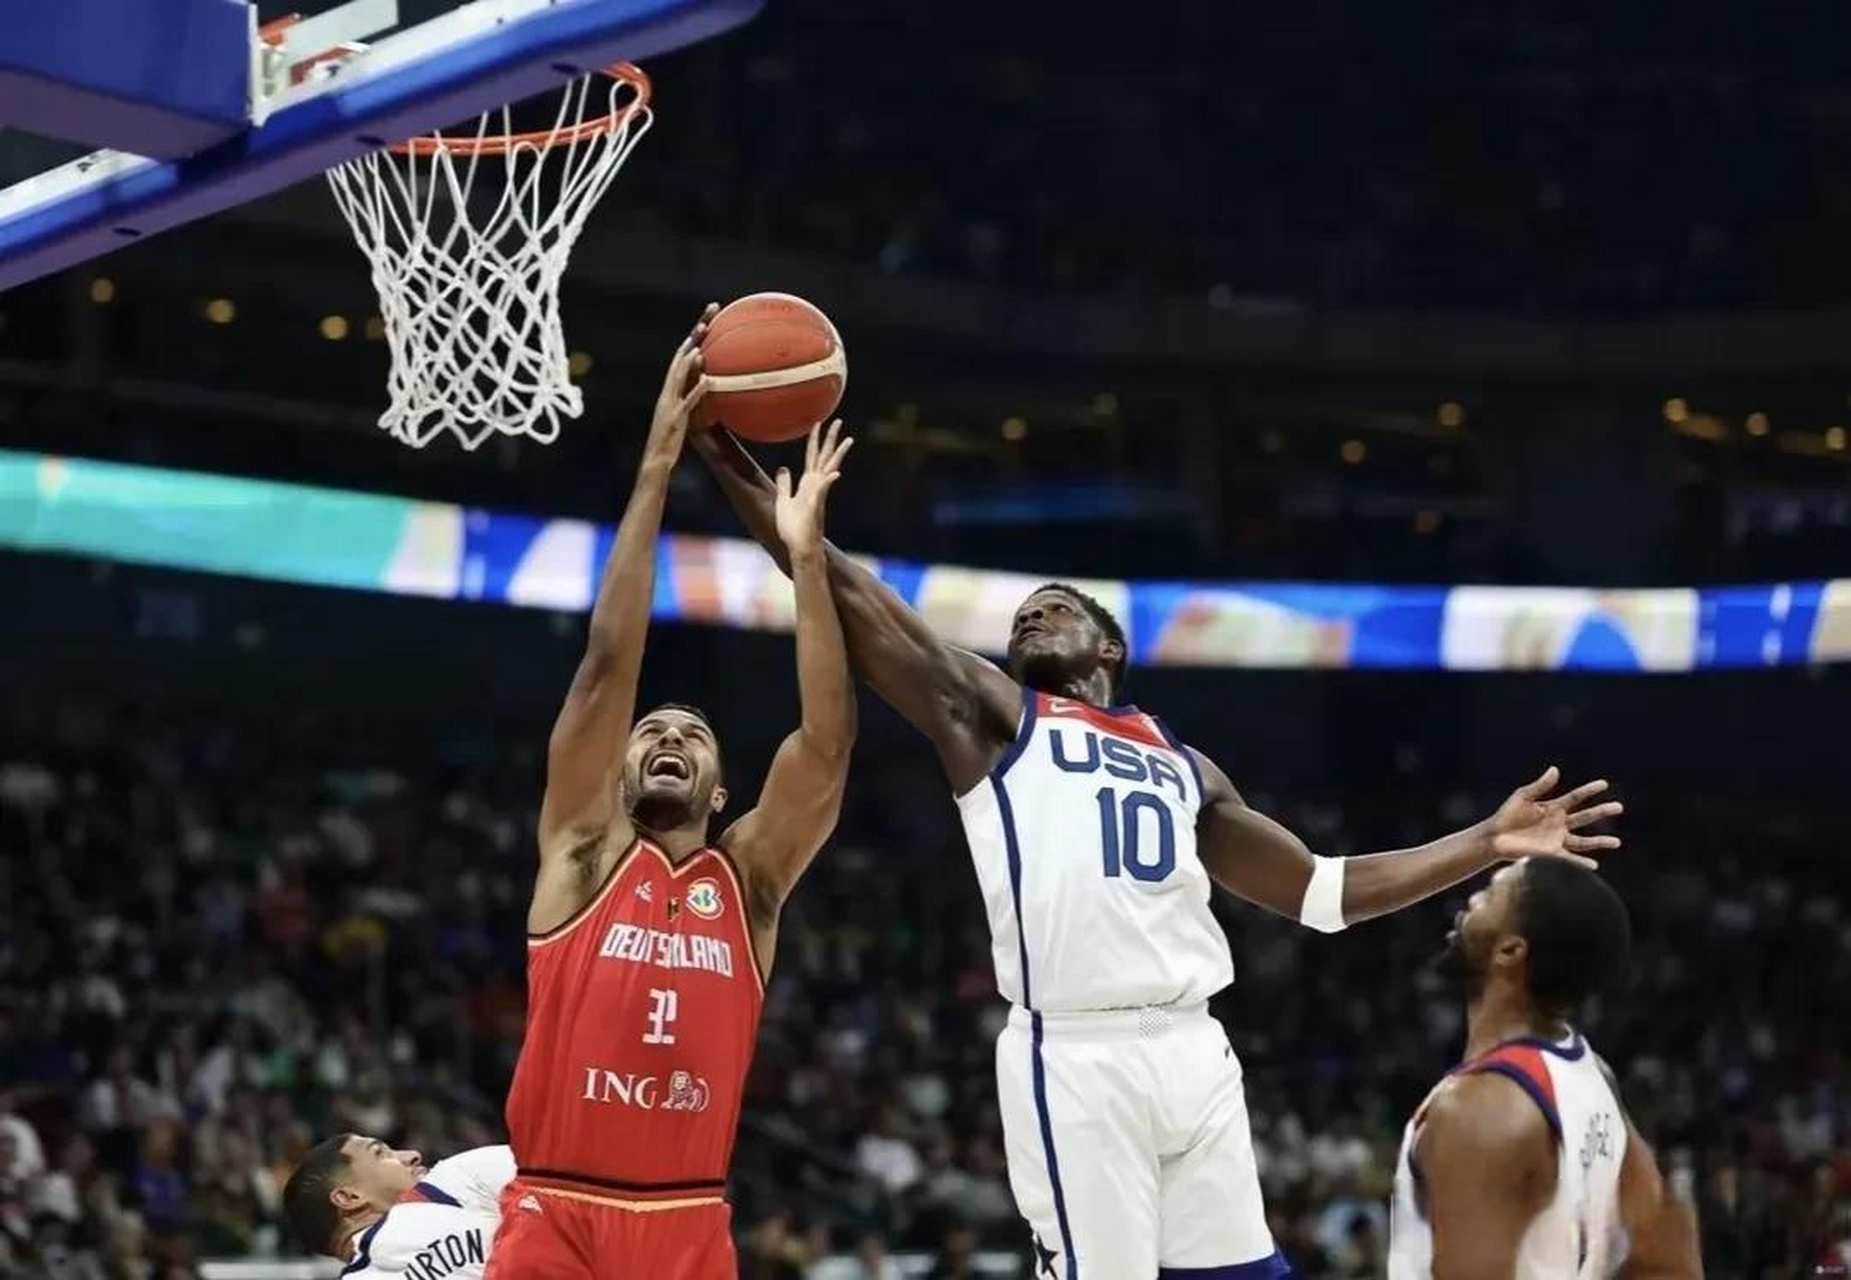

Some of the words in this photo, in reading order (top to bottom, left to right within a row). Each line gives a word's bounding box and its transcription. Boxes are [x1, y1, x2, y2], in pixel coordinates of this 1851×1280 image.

[1049, 729, 1186, 802] USA
[1096, 786, 1176, 882] 10
[599, 922, 734, 978] DEUTSLAND
[583, 1067, 657, 1109] ING
